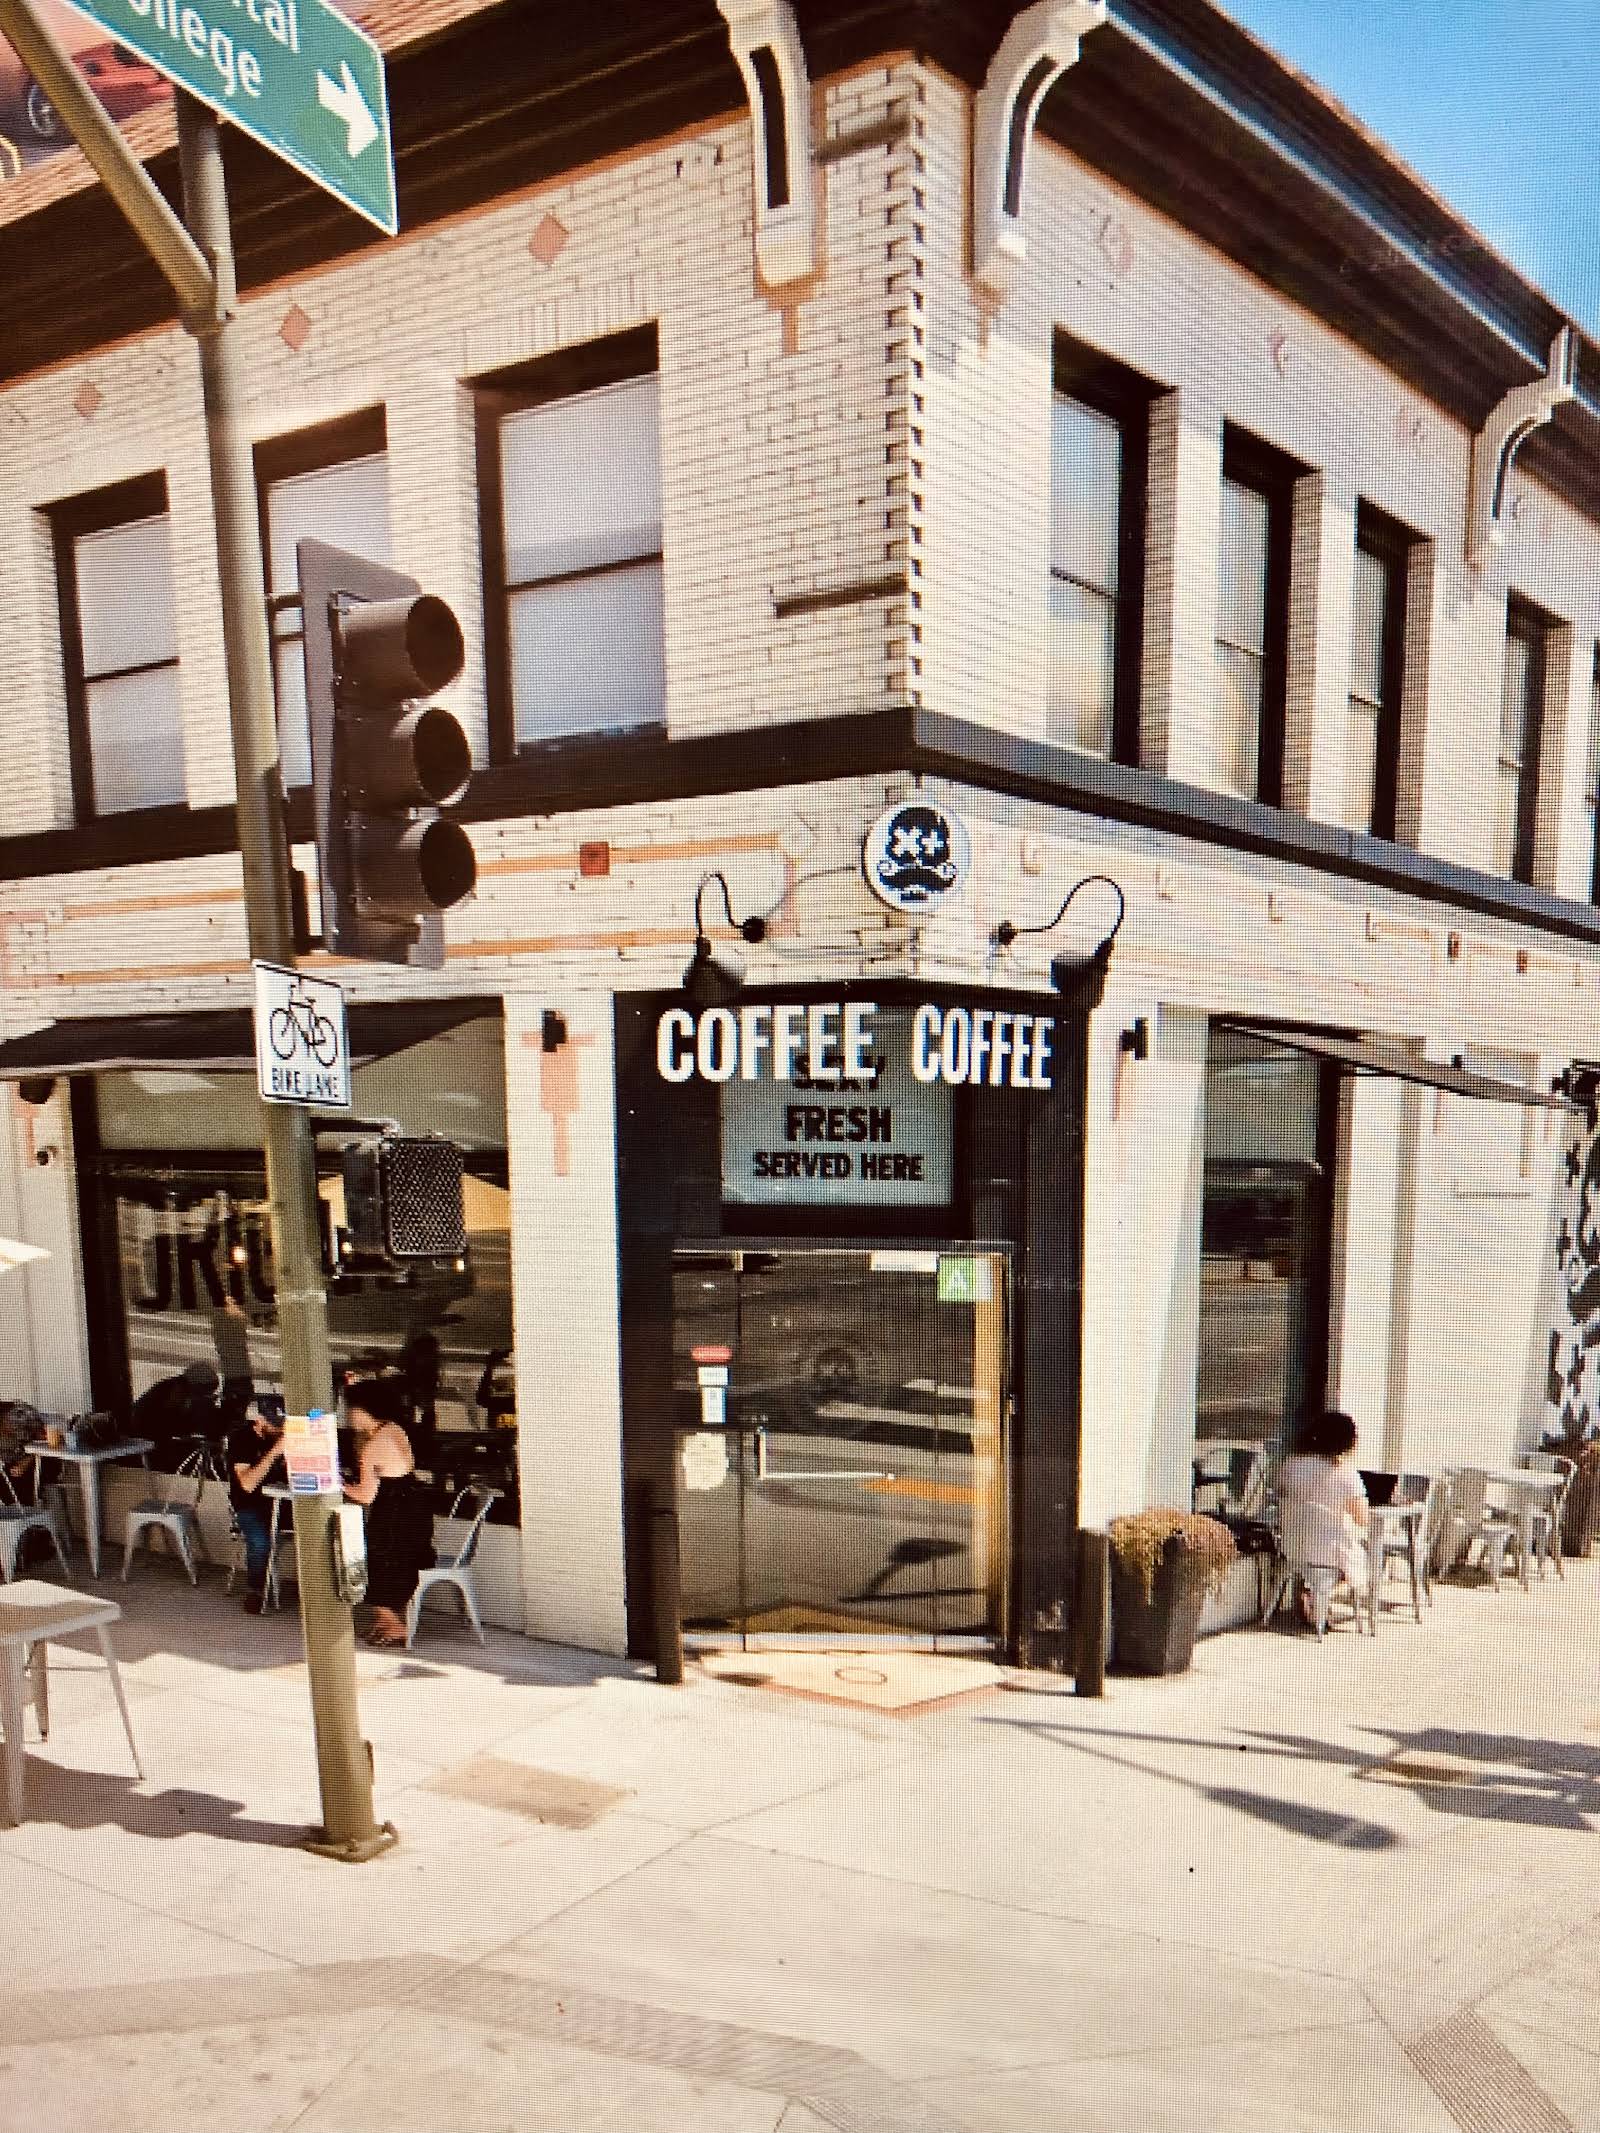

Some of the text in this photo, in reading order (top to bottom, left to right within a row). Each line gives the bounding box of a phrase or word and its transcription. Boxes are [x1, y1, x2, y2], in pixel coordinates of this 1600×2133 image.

[232, 0, 300, 53] tal
[656, 1002, 879, 1083] COFFEE
[912, 1004, 1055, 1088] COFFEE
[271, 1067, 340, 1098] BIKE LANE
[786, 1105, 891, 1143] FRESH
[754, 1152, 923, 1181] SERVED HERE
